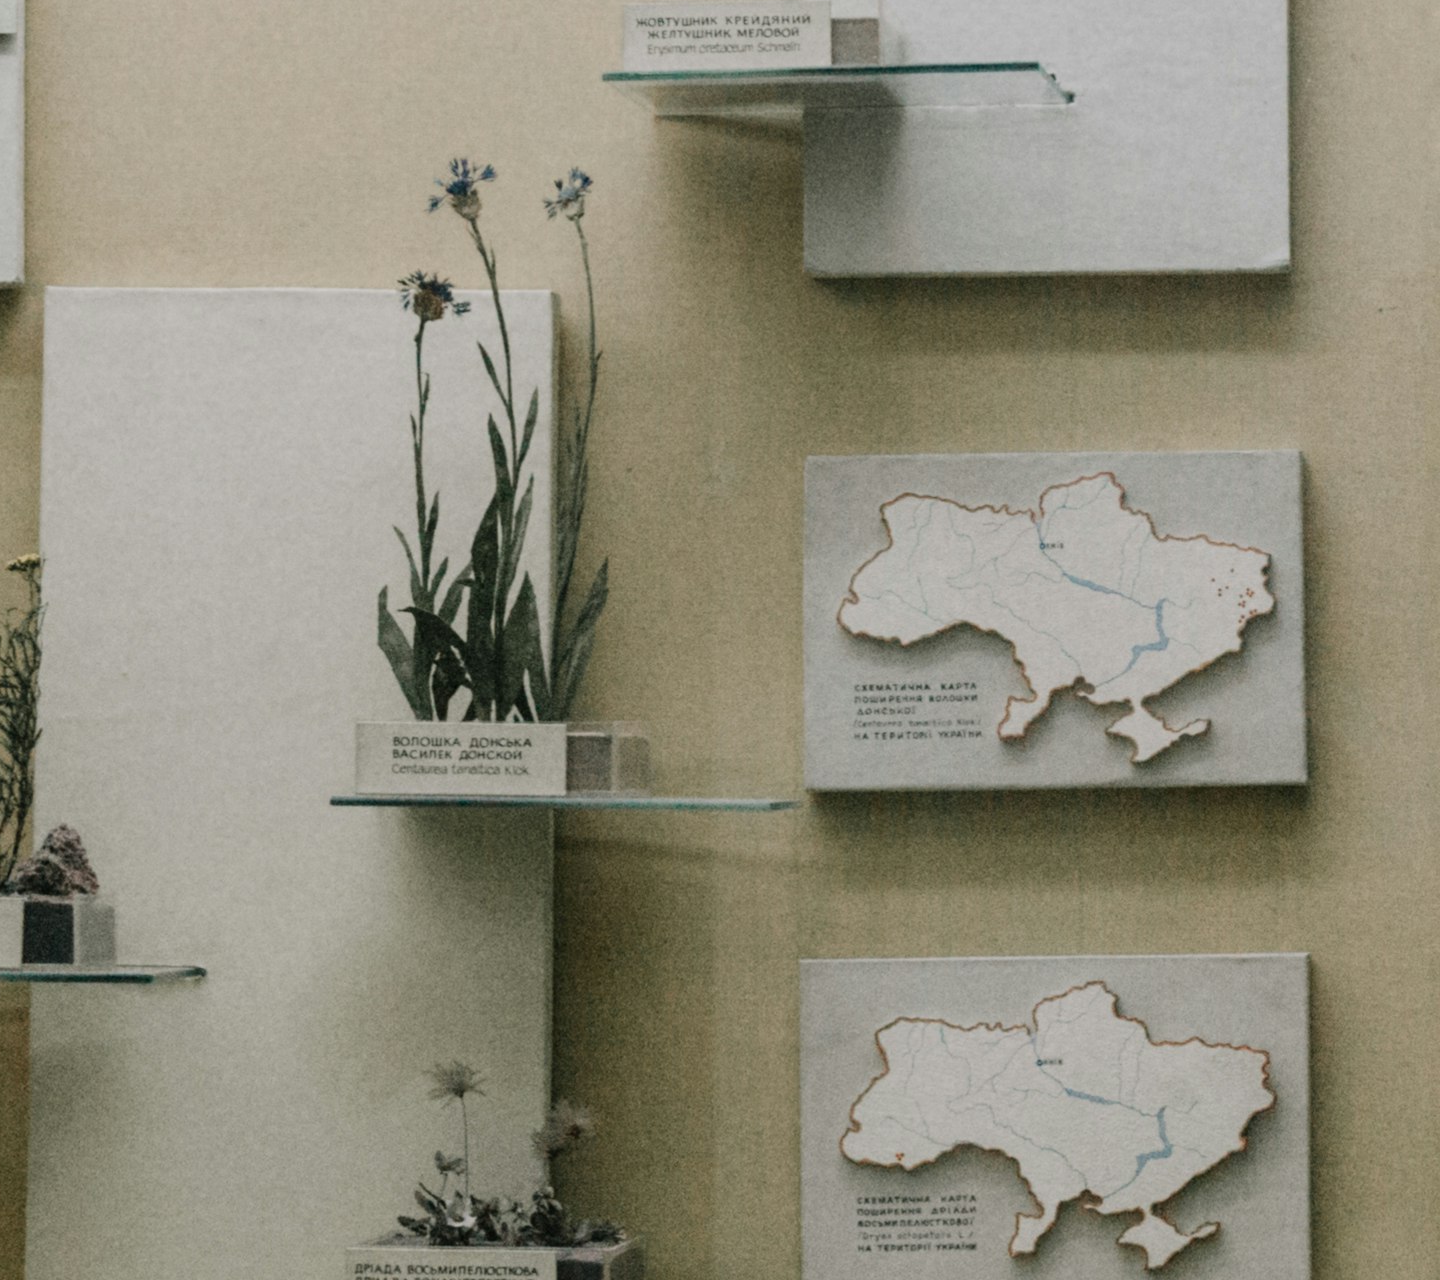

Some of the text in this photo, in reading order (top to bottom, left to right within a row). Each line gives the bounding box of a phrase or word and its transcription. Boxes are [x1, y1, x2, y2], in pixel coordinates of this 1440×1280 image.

[636, 14, 811, 28] ЖОВТУШНИК КРЕЙДЯНИЙ
[648, 27, 799, 40] ЖЕЛТУШНИК МЕЛОВОЙ
[854, 682, 977, 692] СХЕМАТИЧНА КАРТА
[854, 695, 923, 704] ПОШИРЕННЯ
[854, 732, 869, 740] НА
[938, 730, 982, 739] УКРАЇНИ
[393, 736, 532, 748] ВОЛОШКА ДОНСЬКА
[392, 748, 523, 761] ВАСИЛЕК ДОНСКОЙ
[857, 1194, 976, 1205] СХЕМАТИЧНА КАРТА
[857, 1206, 976, 1216] ПОШИРЕННЯ ДРІАДИ
[936, 1243, 977, 1251] УКРАЇНИ
[355, 1263, 539, 1276] ДРІАДА ВОСЬМИПЕЛЮСТКОВА
